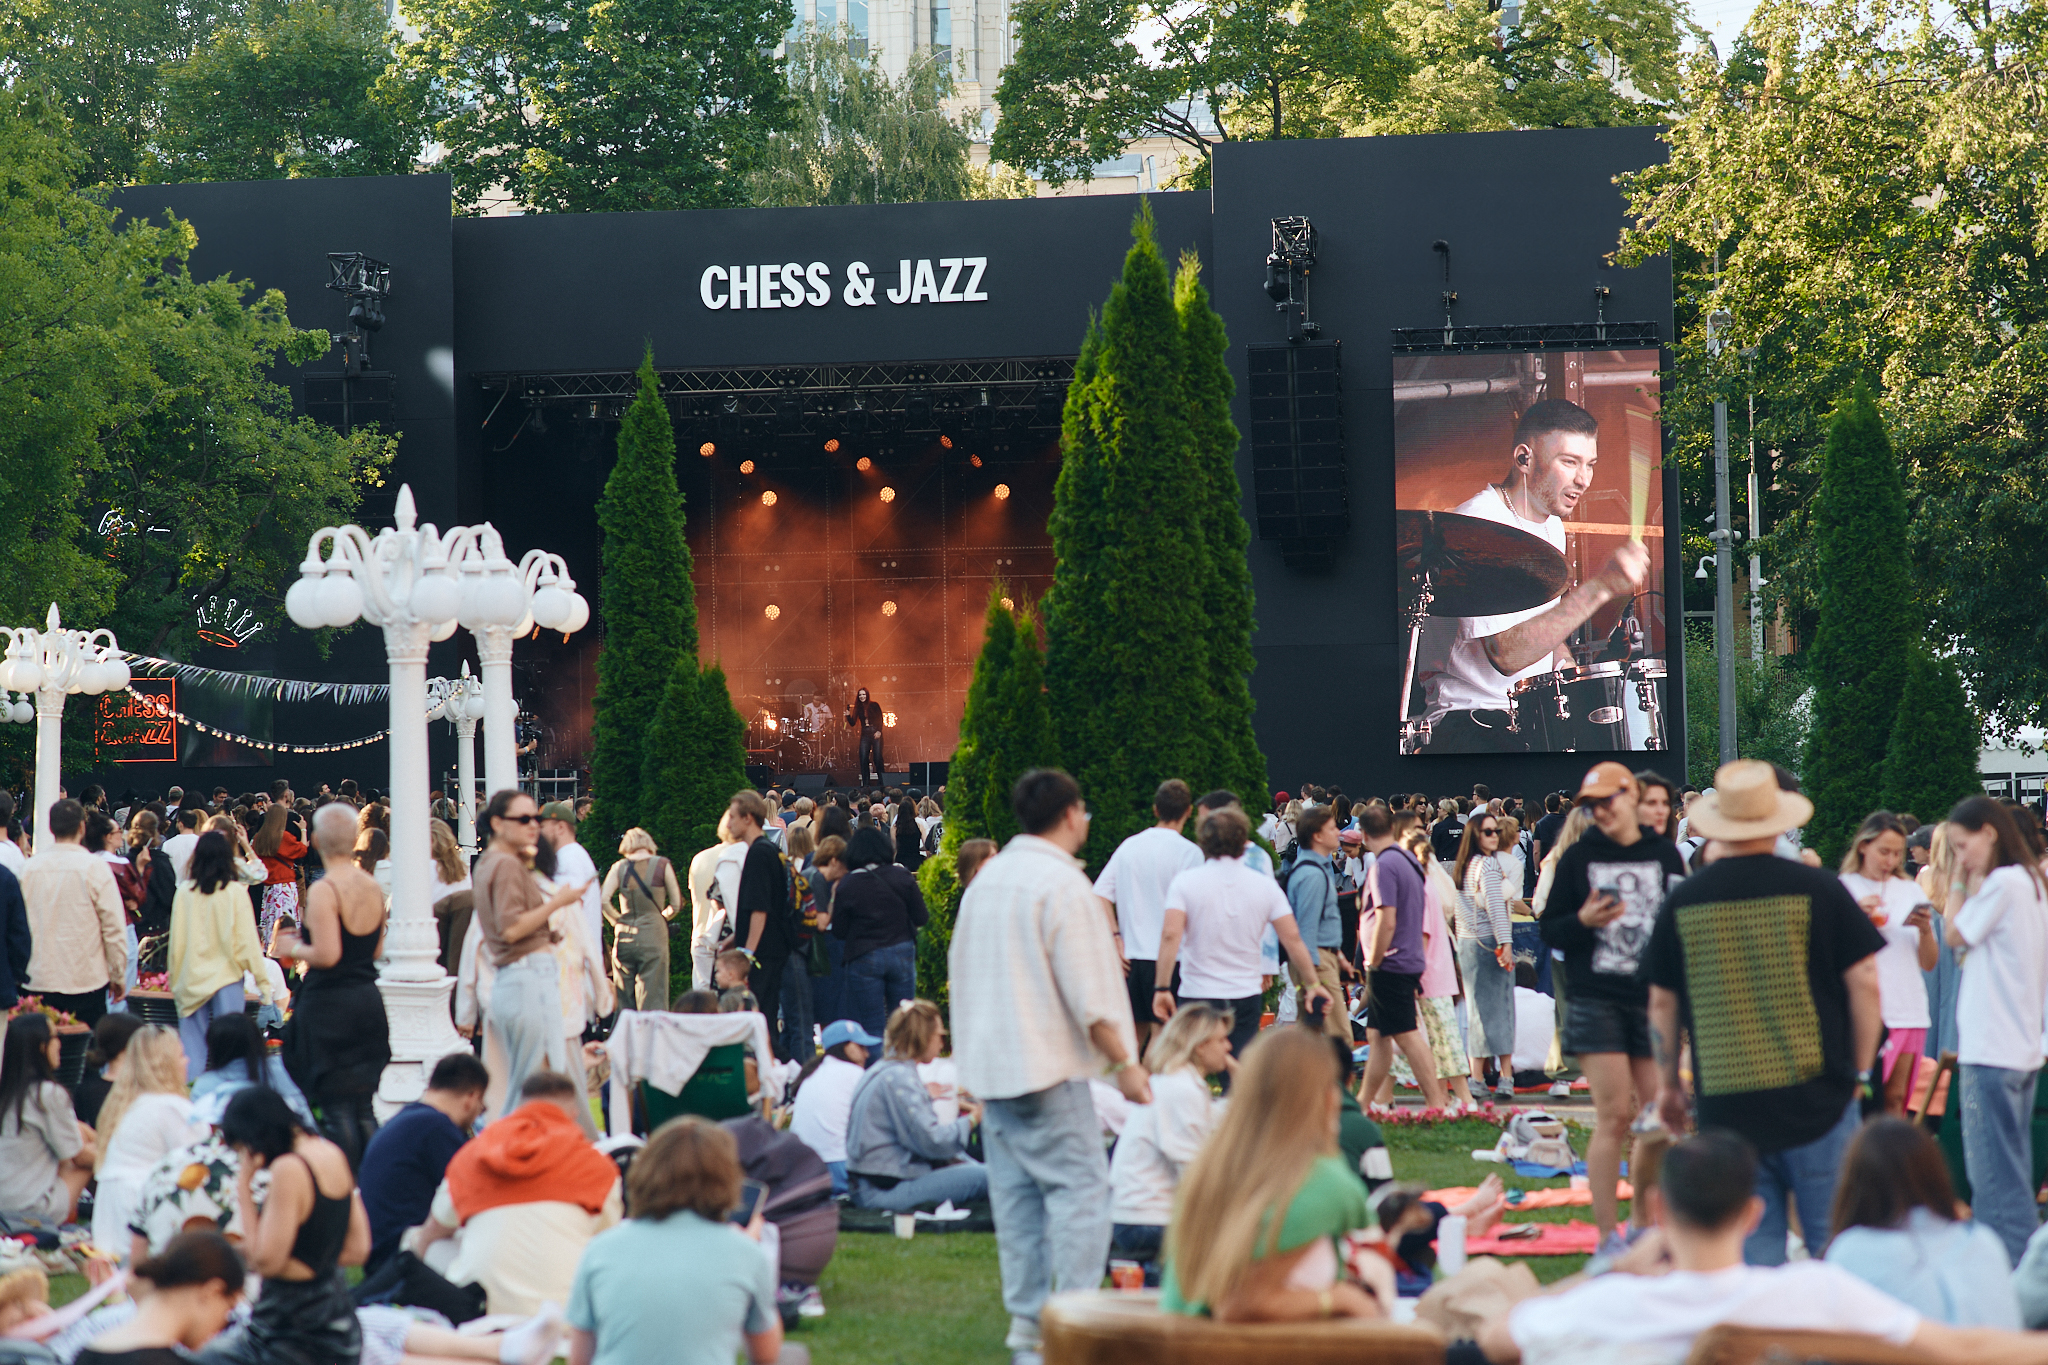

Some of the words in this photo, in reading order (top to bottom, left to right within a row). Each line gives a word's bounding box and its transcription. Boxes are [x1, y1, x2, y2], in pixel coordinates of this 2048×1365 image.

[700, 261, 831, 310] CHESS
[843, 260, 876, 307] &
[886, 256, 989, 305] JAZZ
